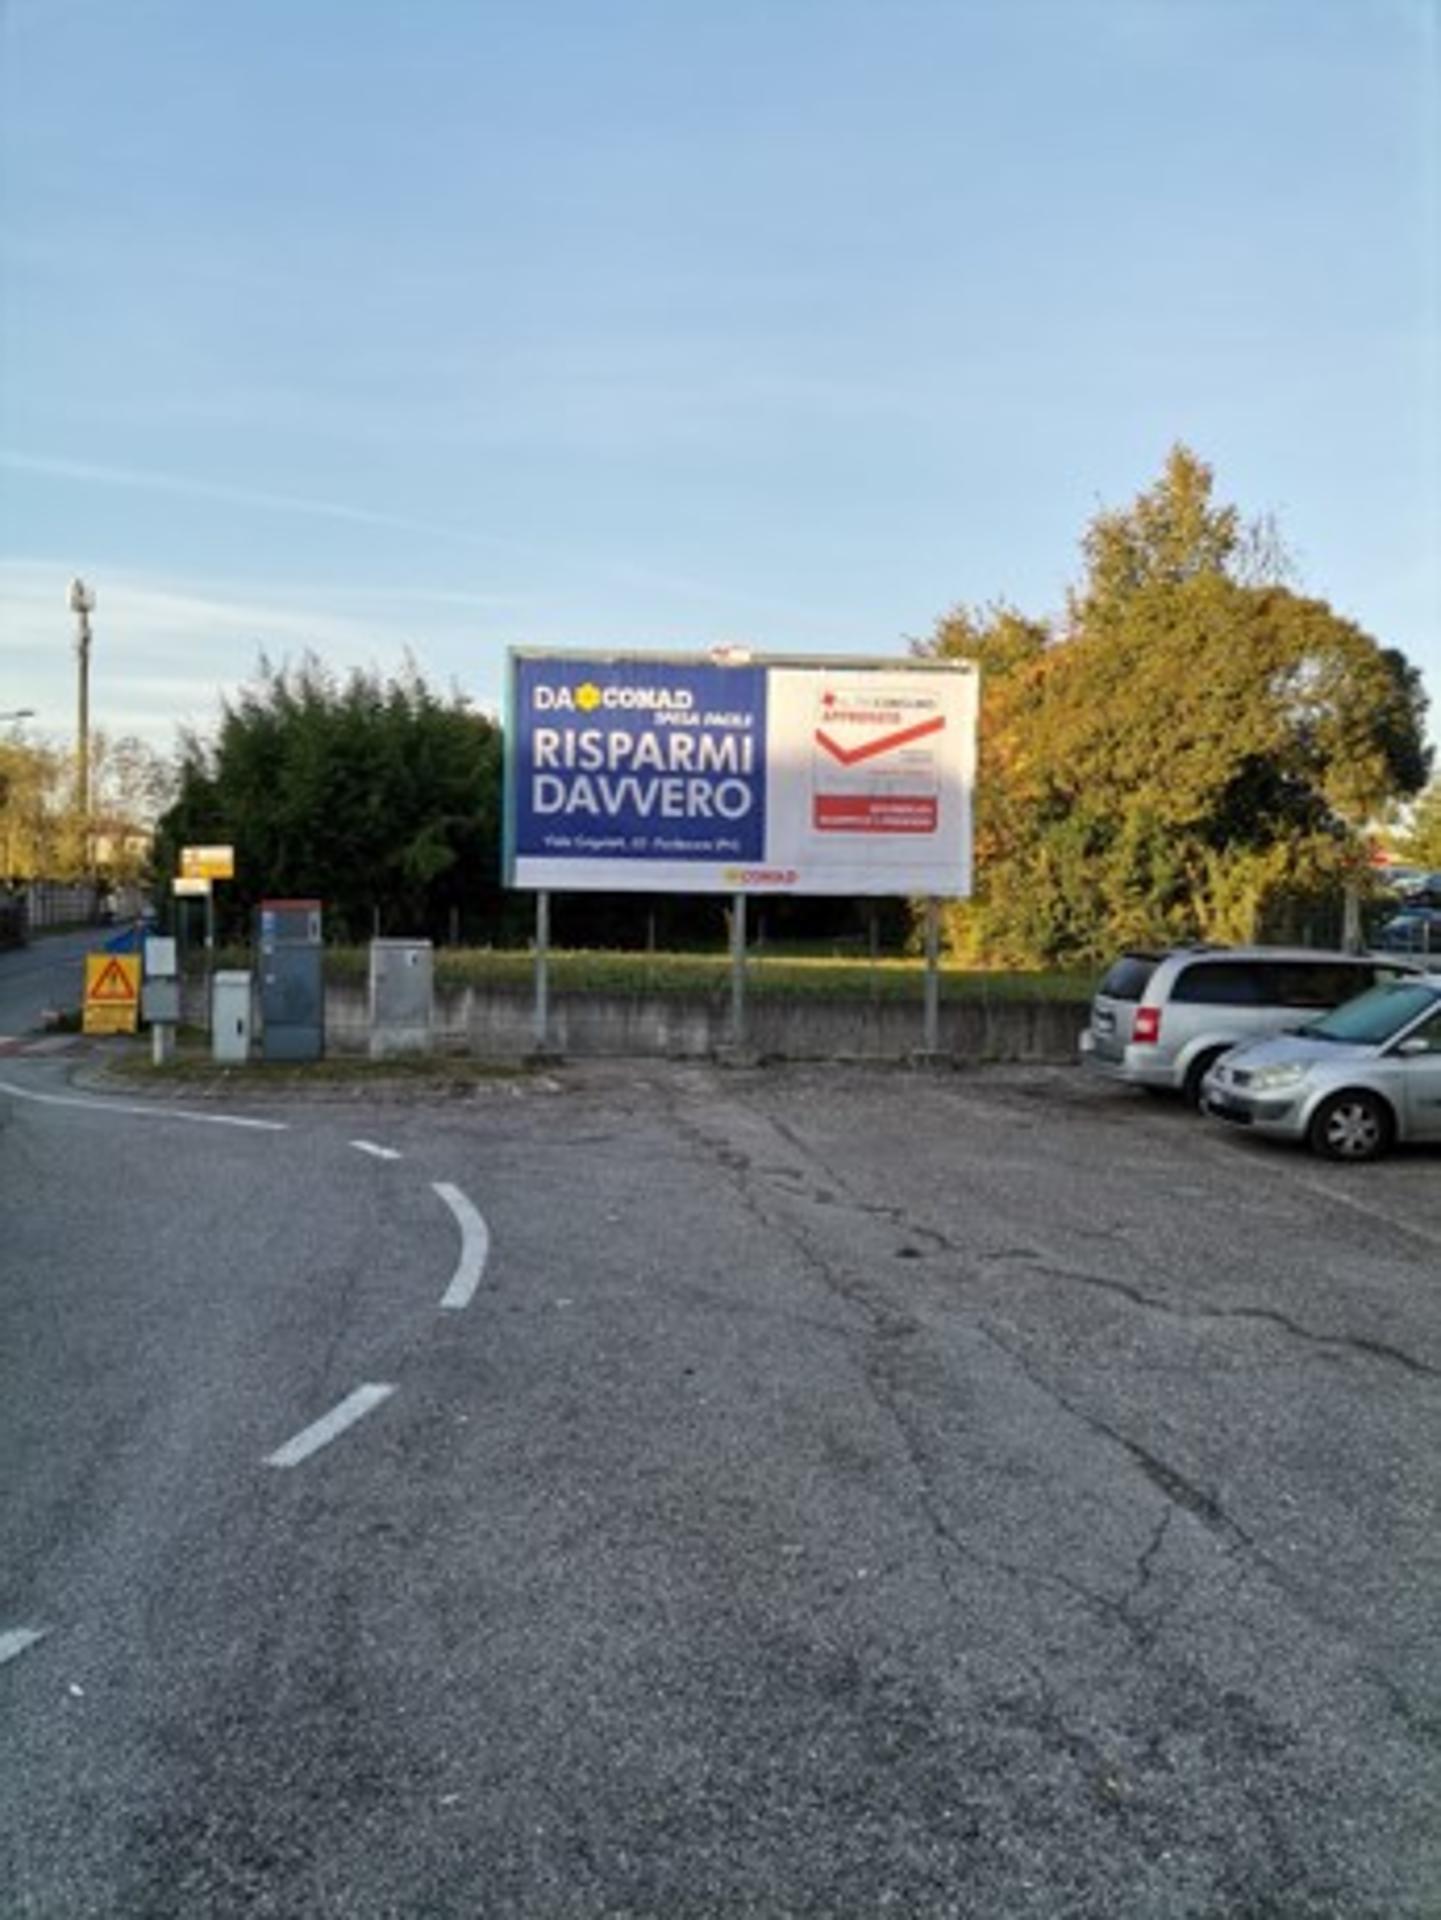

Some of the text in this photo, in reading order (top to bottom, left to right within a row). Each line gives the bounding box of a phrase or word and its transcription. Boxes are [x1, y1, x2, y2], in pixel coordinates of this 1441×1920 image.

[533, 686, 694, 709] DA CONAD
[533, 729, 753, 773] RISPARMI
[532, 775, 752, 819] DAVVERO
